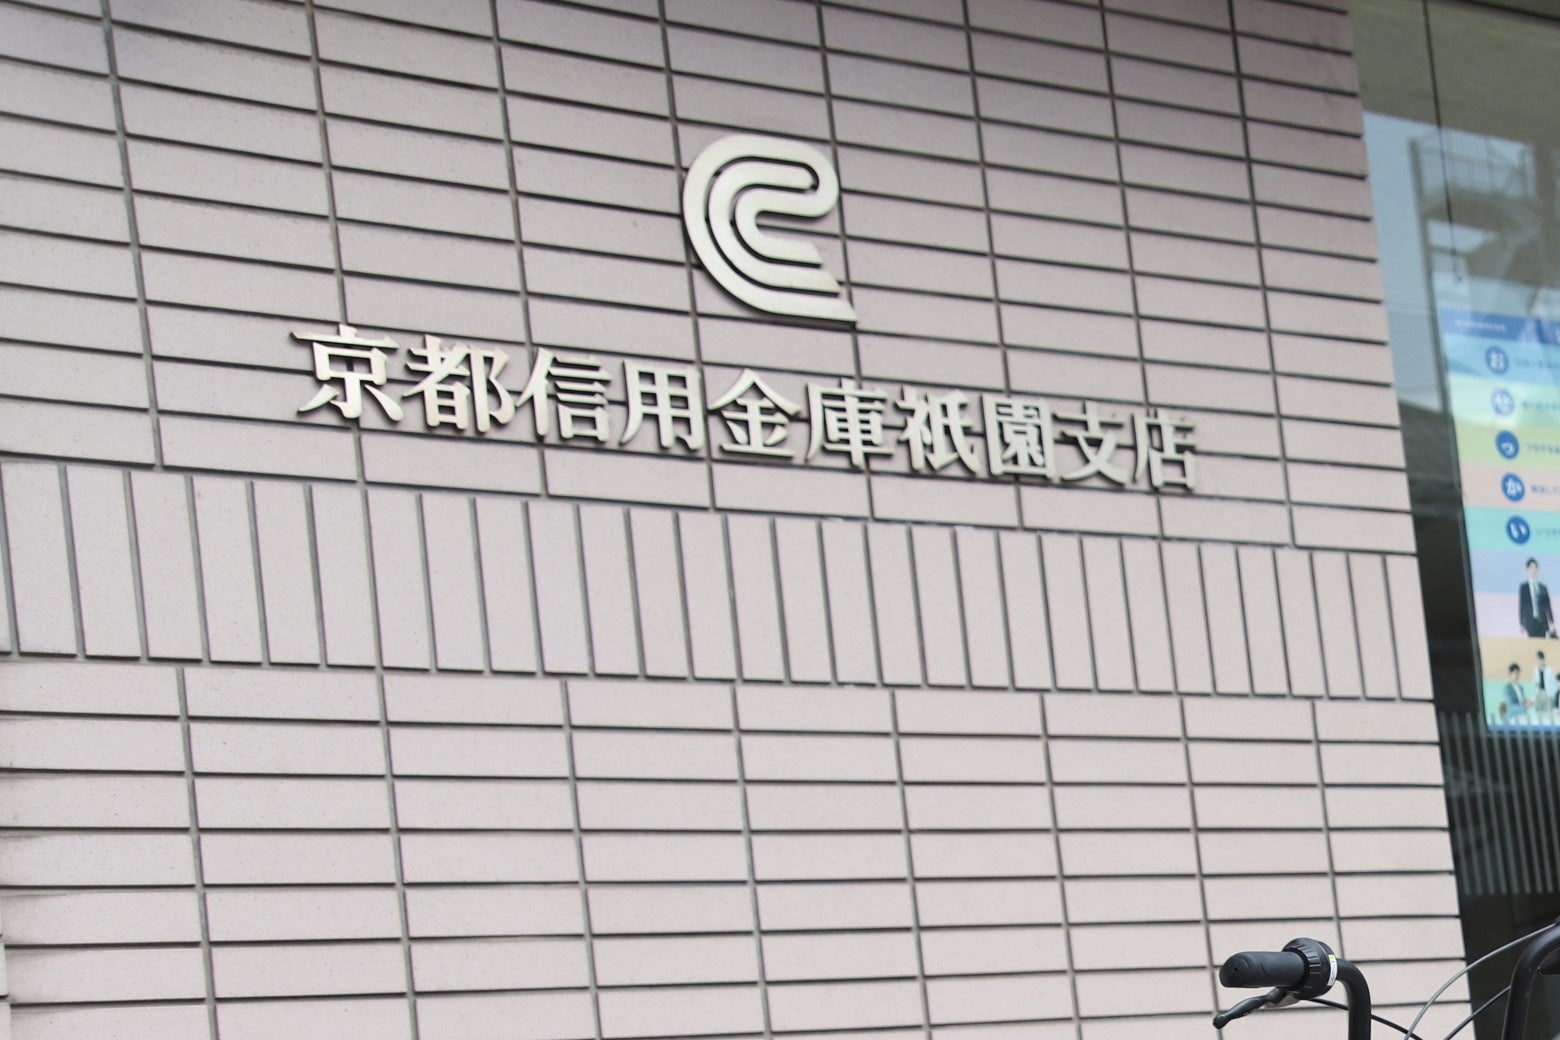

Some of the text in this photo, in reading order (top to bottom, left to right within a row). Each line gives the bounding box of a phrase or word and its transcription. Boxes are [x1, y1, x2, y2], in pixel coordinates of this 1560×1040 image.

[289, 323, 1197, 492] 京都信用金庫祇園支店
